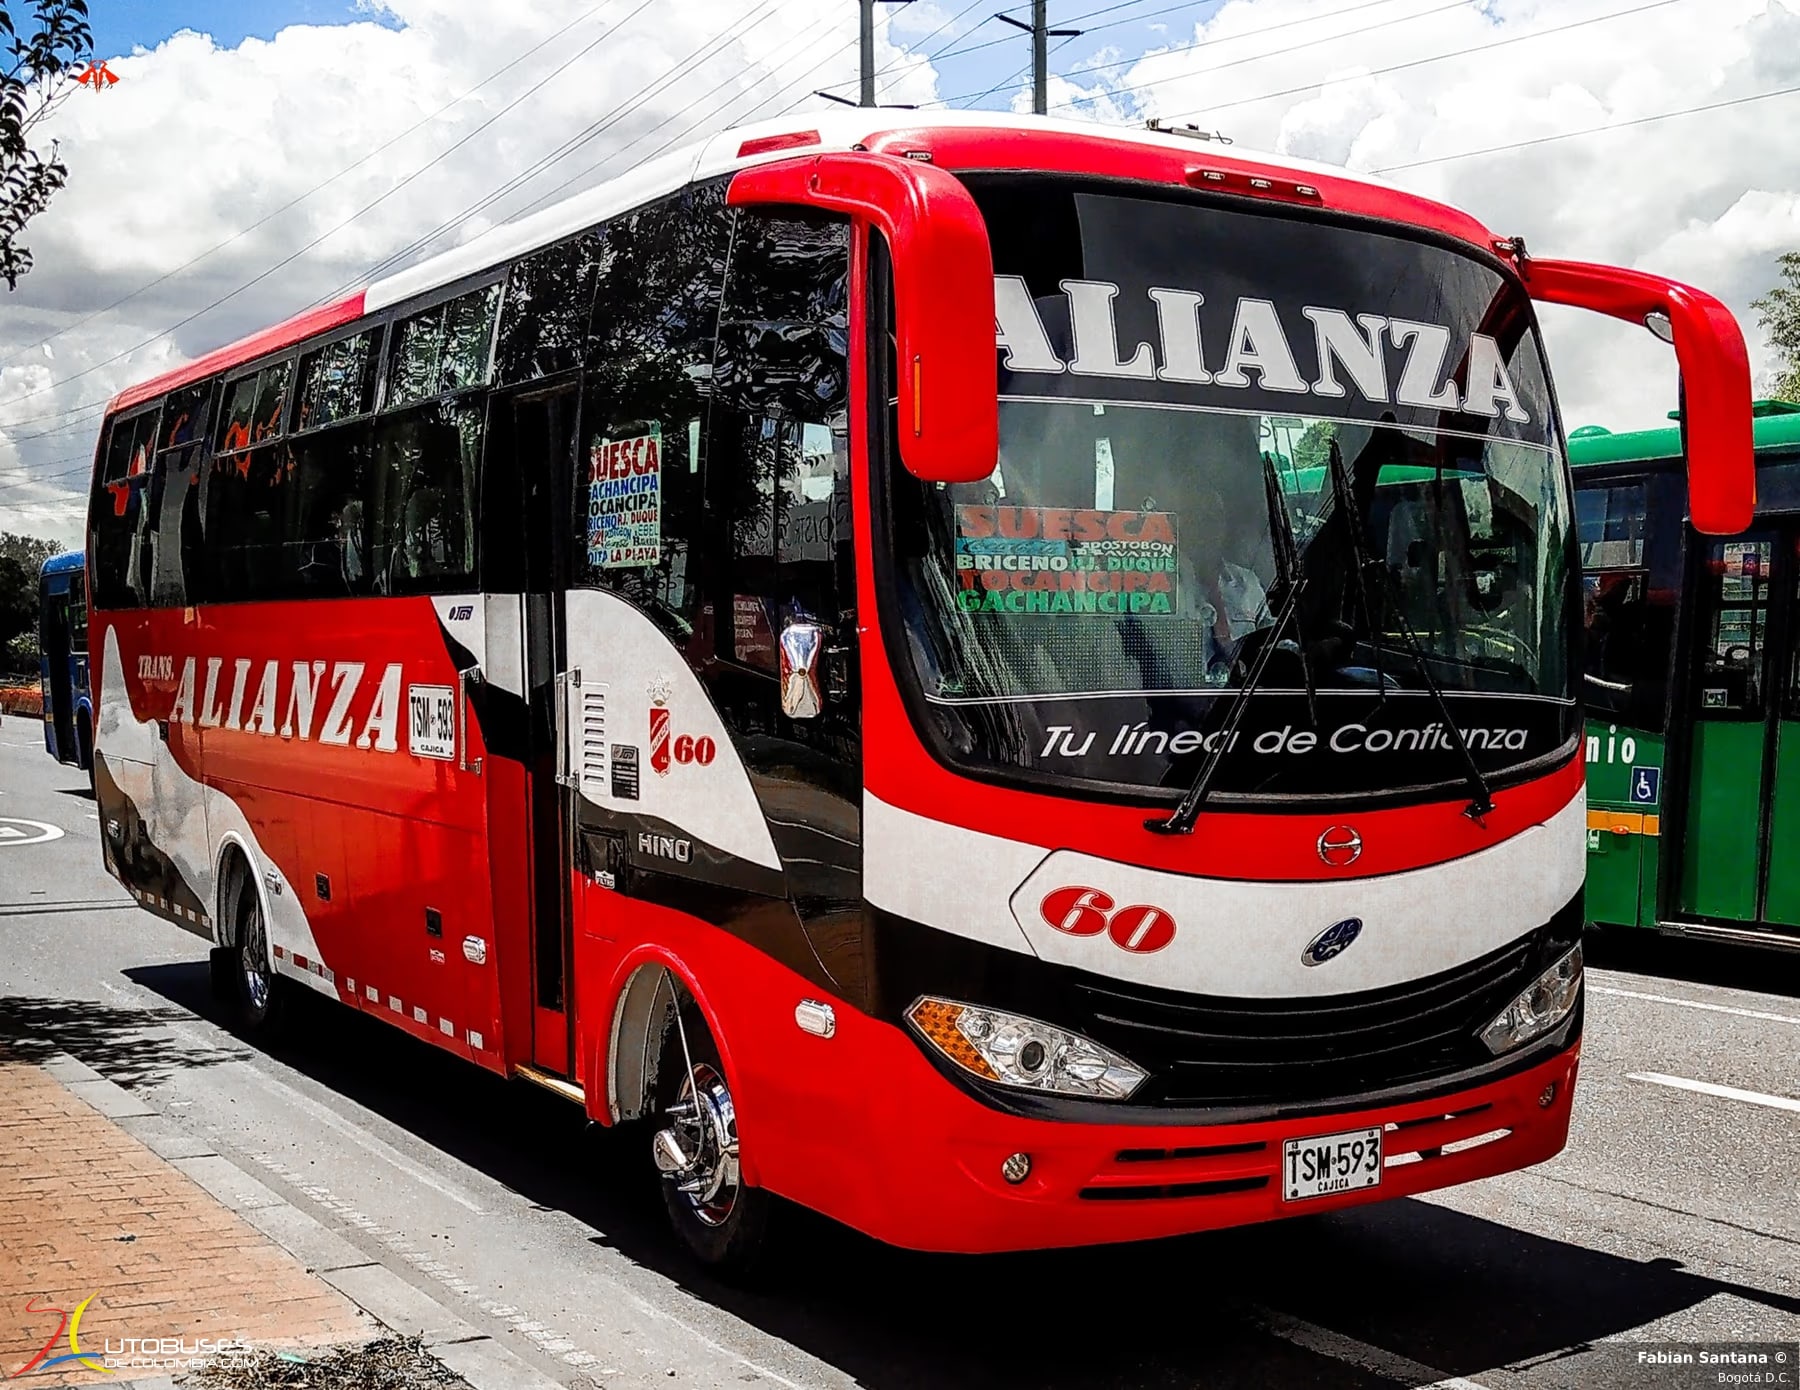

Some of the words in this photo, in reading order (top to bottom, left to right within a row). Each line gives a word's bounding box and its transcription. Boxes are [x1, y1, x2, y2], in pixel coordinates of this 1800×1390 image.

[994, 275, 1530, 423] ALIANZA
[589, 474, 658, 501] ACHANCIPA
[589, 493, 658, 517] OCANCIPA
[587, 515, 617, 531] RICENO
[960, 506, 1175, 541] SUESCA
[611, 549, 622, 563] LA
[956, 554, 1069, 571] BRICENO
[1107, 556, 1175, 572] DUQUE
[958, 571, 1172, 592] TOCANCIPA
[957, 589, 1172, 613] GACHANCIPA
[169, 656, 403, 753] ALIANZA
[421, 744, 444, 754] CAJICA
[674, 734, 716, 767] 60
[1040, 726, 1089, 757] Tu
[1110, 723, 1240, 755] línea
[1253, 725, 1317, 754] de
[1330, 722, 1528, 751] Confianza
[638, 832, 692, 863] HINO
[1040, 885, 1177, 954] 60
[1318, 1178, 1349, 1192] CAJICA
